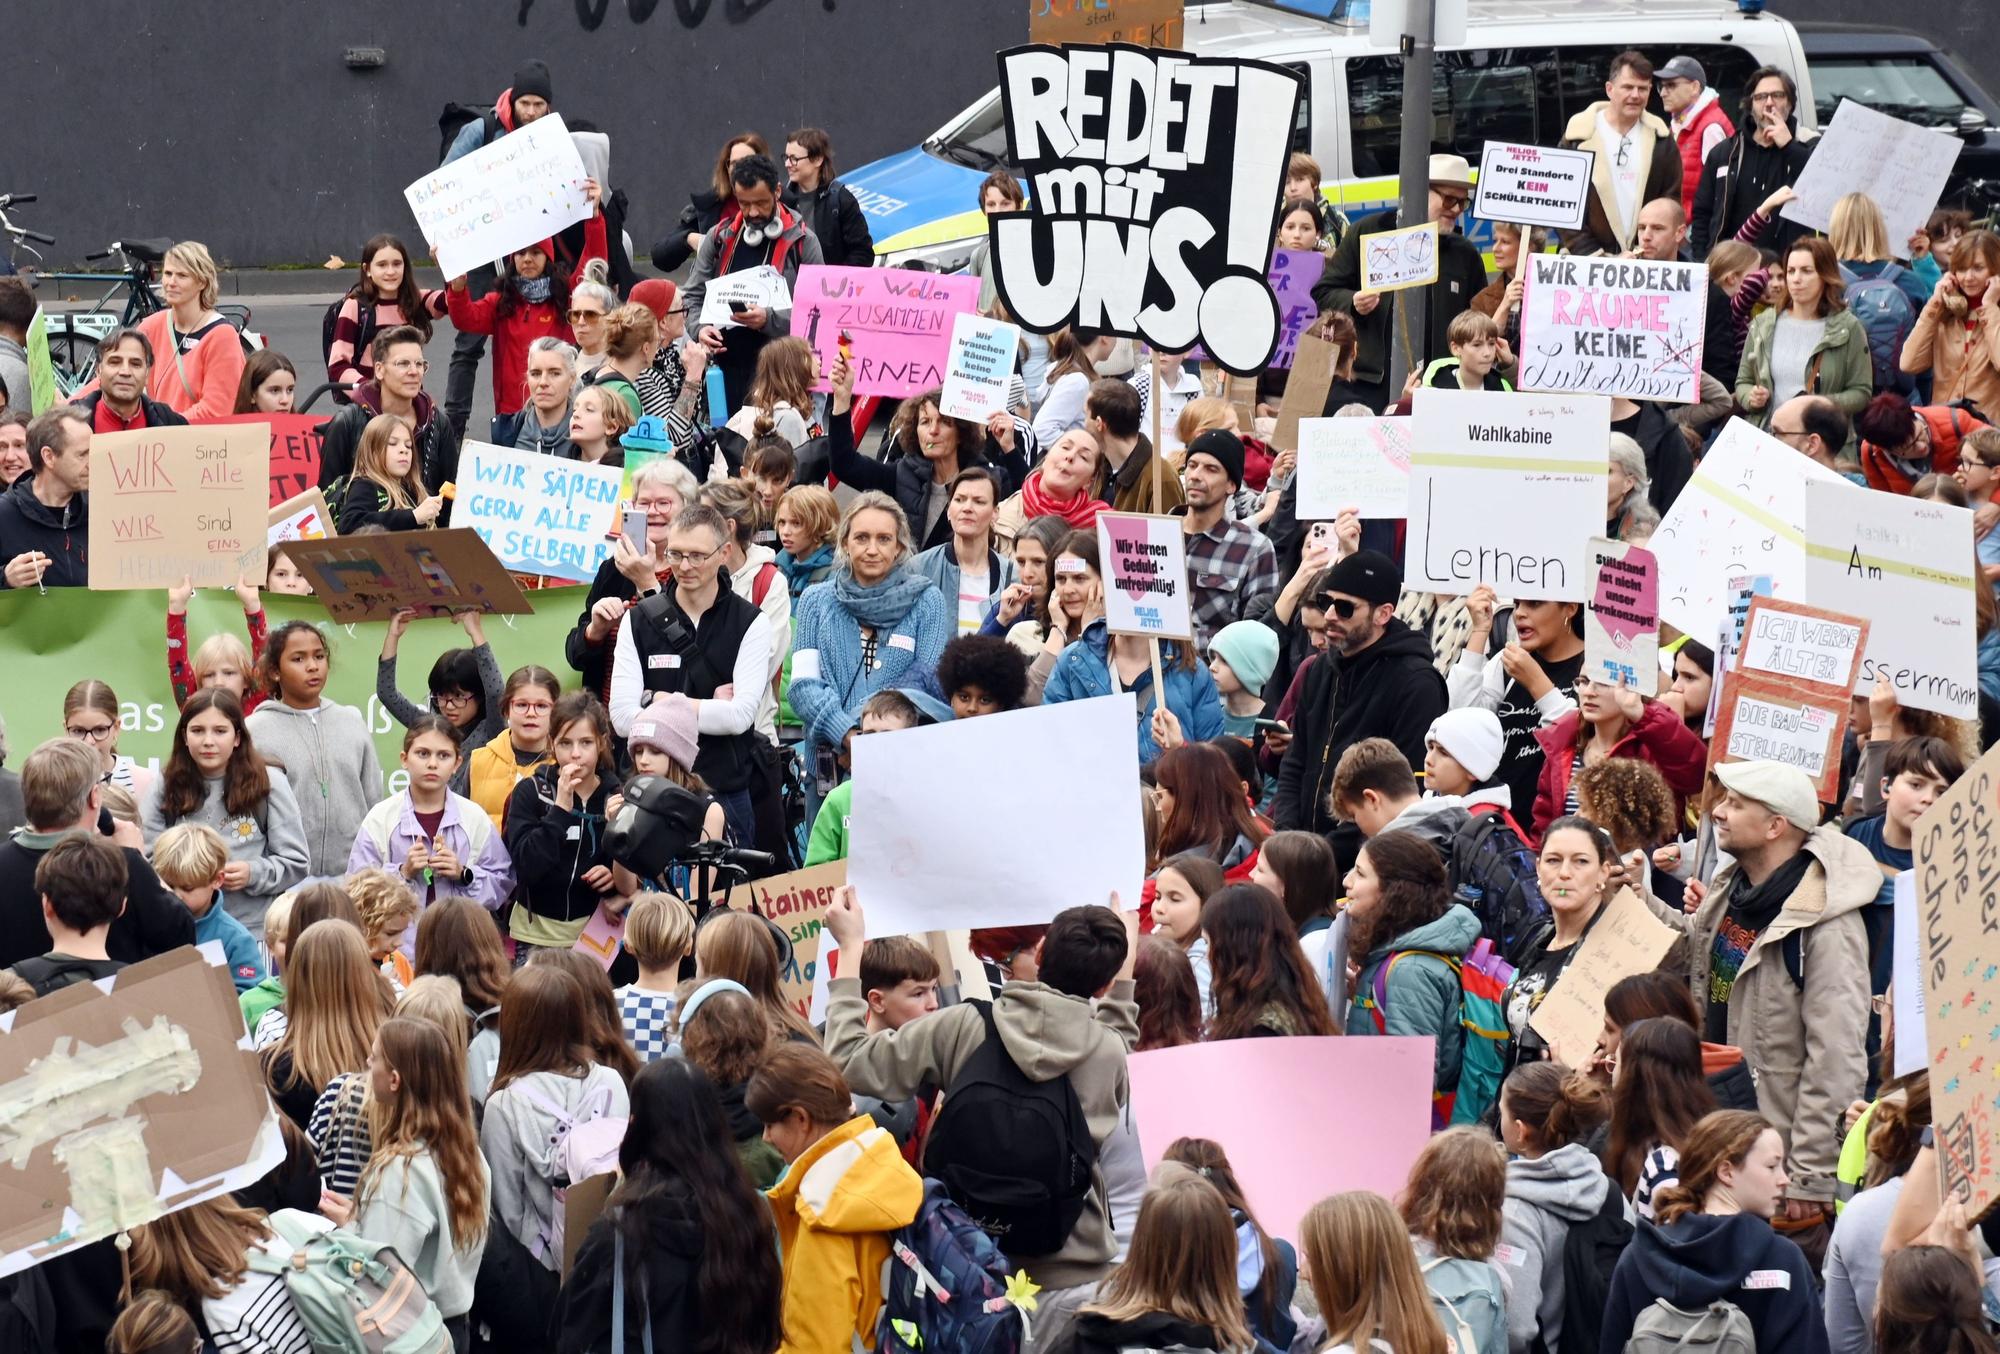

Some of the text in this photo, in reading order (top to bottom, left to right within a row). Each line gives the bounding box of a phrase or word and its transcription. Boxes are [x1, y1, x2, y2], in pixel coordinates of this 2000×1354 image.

[1005, 50, 1236, 171] REDET
[1506, 146, 1538, 155] HELIOS
[1511, 154, 1541, 163] JETZT!
[1496, 164, 1574, 181] Drei Standorte
[1035, 165, 1165, 221] mit
[1517, 179, 1549, 193] KEIN
[1484, 191, 1577, 210] SCHÜLERTICKET!
[821, 276, 865, 298] Wir
[1588, 262, 1691, 292] FORDERN
[717, 290, 759, 299] verdienen
[836, 304, 944, 331] ZUSAMMEN
[1552, 286, 1670, 332] RÄUME
[958, 338, 1006, 356] brauchen
[975, 330, 993, 342] Wir
[962, 350, 997, 364] Räume
[964, 361, 992, 374] keine
[952, 369, 1004, 387] Ausreden!
[1468, 424, 1553, 446] Wahlkabine
[108, 440, 227, 489] WIR Sind
[201, 461, 243, 484] Alle
[475, 456, 618, 509] WIR SÄßEN
[112, 508, 232, 538] WIR Sind
[470, 495, 590, 531] GERN ALLE
[1424, 476, 1566, 590] Lernen
[207, 539, 241, 550] EINS
[504, 531, 586, 565] SELBEN
[1115, 539, 1168, 556] Wir lernen
[1123, 558, 1158, 574] Geduld
[1596, 553, 1646, 577] Stillstand
[1847, 543, 1882, 581] Am
[1115, 576, 1175, 597] unfreiwillig!
[1600, 570, 1642, 592] ist nicht
[1606, 590, 1636, 606] unser
[1134, 606, 1159, 618] HELIOS
[1588, 600, 1654, 628] Lernkonzept!
[1140, 618, 1163, 629] JETZT!
[1757, 615, 1859, 649] ICH WERDE
[1765, 645, 1837, 680] ÄLTER
[1738, 702, 1768, 725] DIE
[1950, 801, 1969, 904] ohne
[1969, 772, 2000, 935] Schüler
[1920, 823, 1953, 991] Schule
